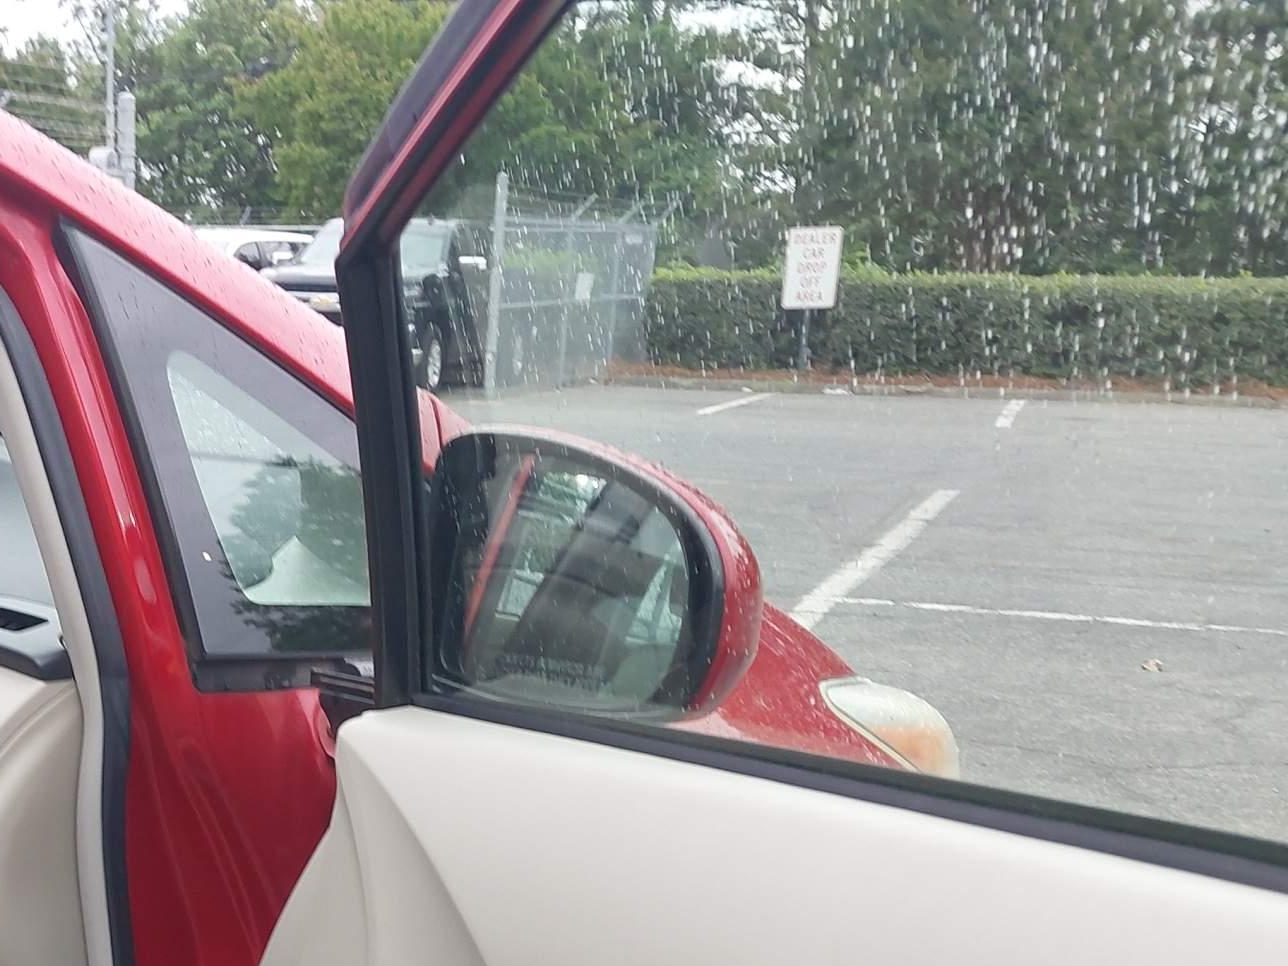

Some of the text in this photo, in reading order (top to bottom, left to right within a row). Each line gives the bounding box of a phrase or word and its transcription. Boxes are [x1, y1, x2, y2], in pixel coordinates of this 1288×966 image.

[793, 231, 838, 245] DEALER
[802, 247, 825, 259] CAR
[797, 261, 828, 274] DROP
[799, 275, 822, 289] OFF
[795, 290, 824, 302] AREA
